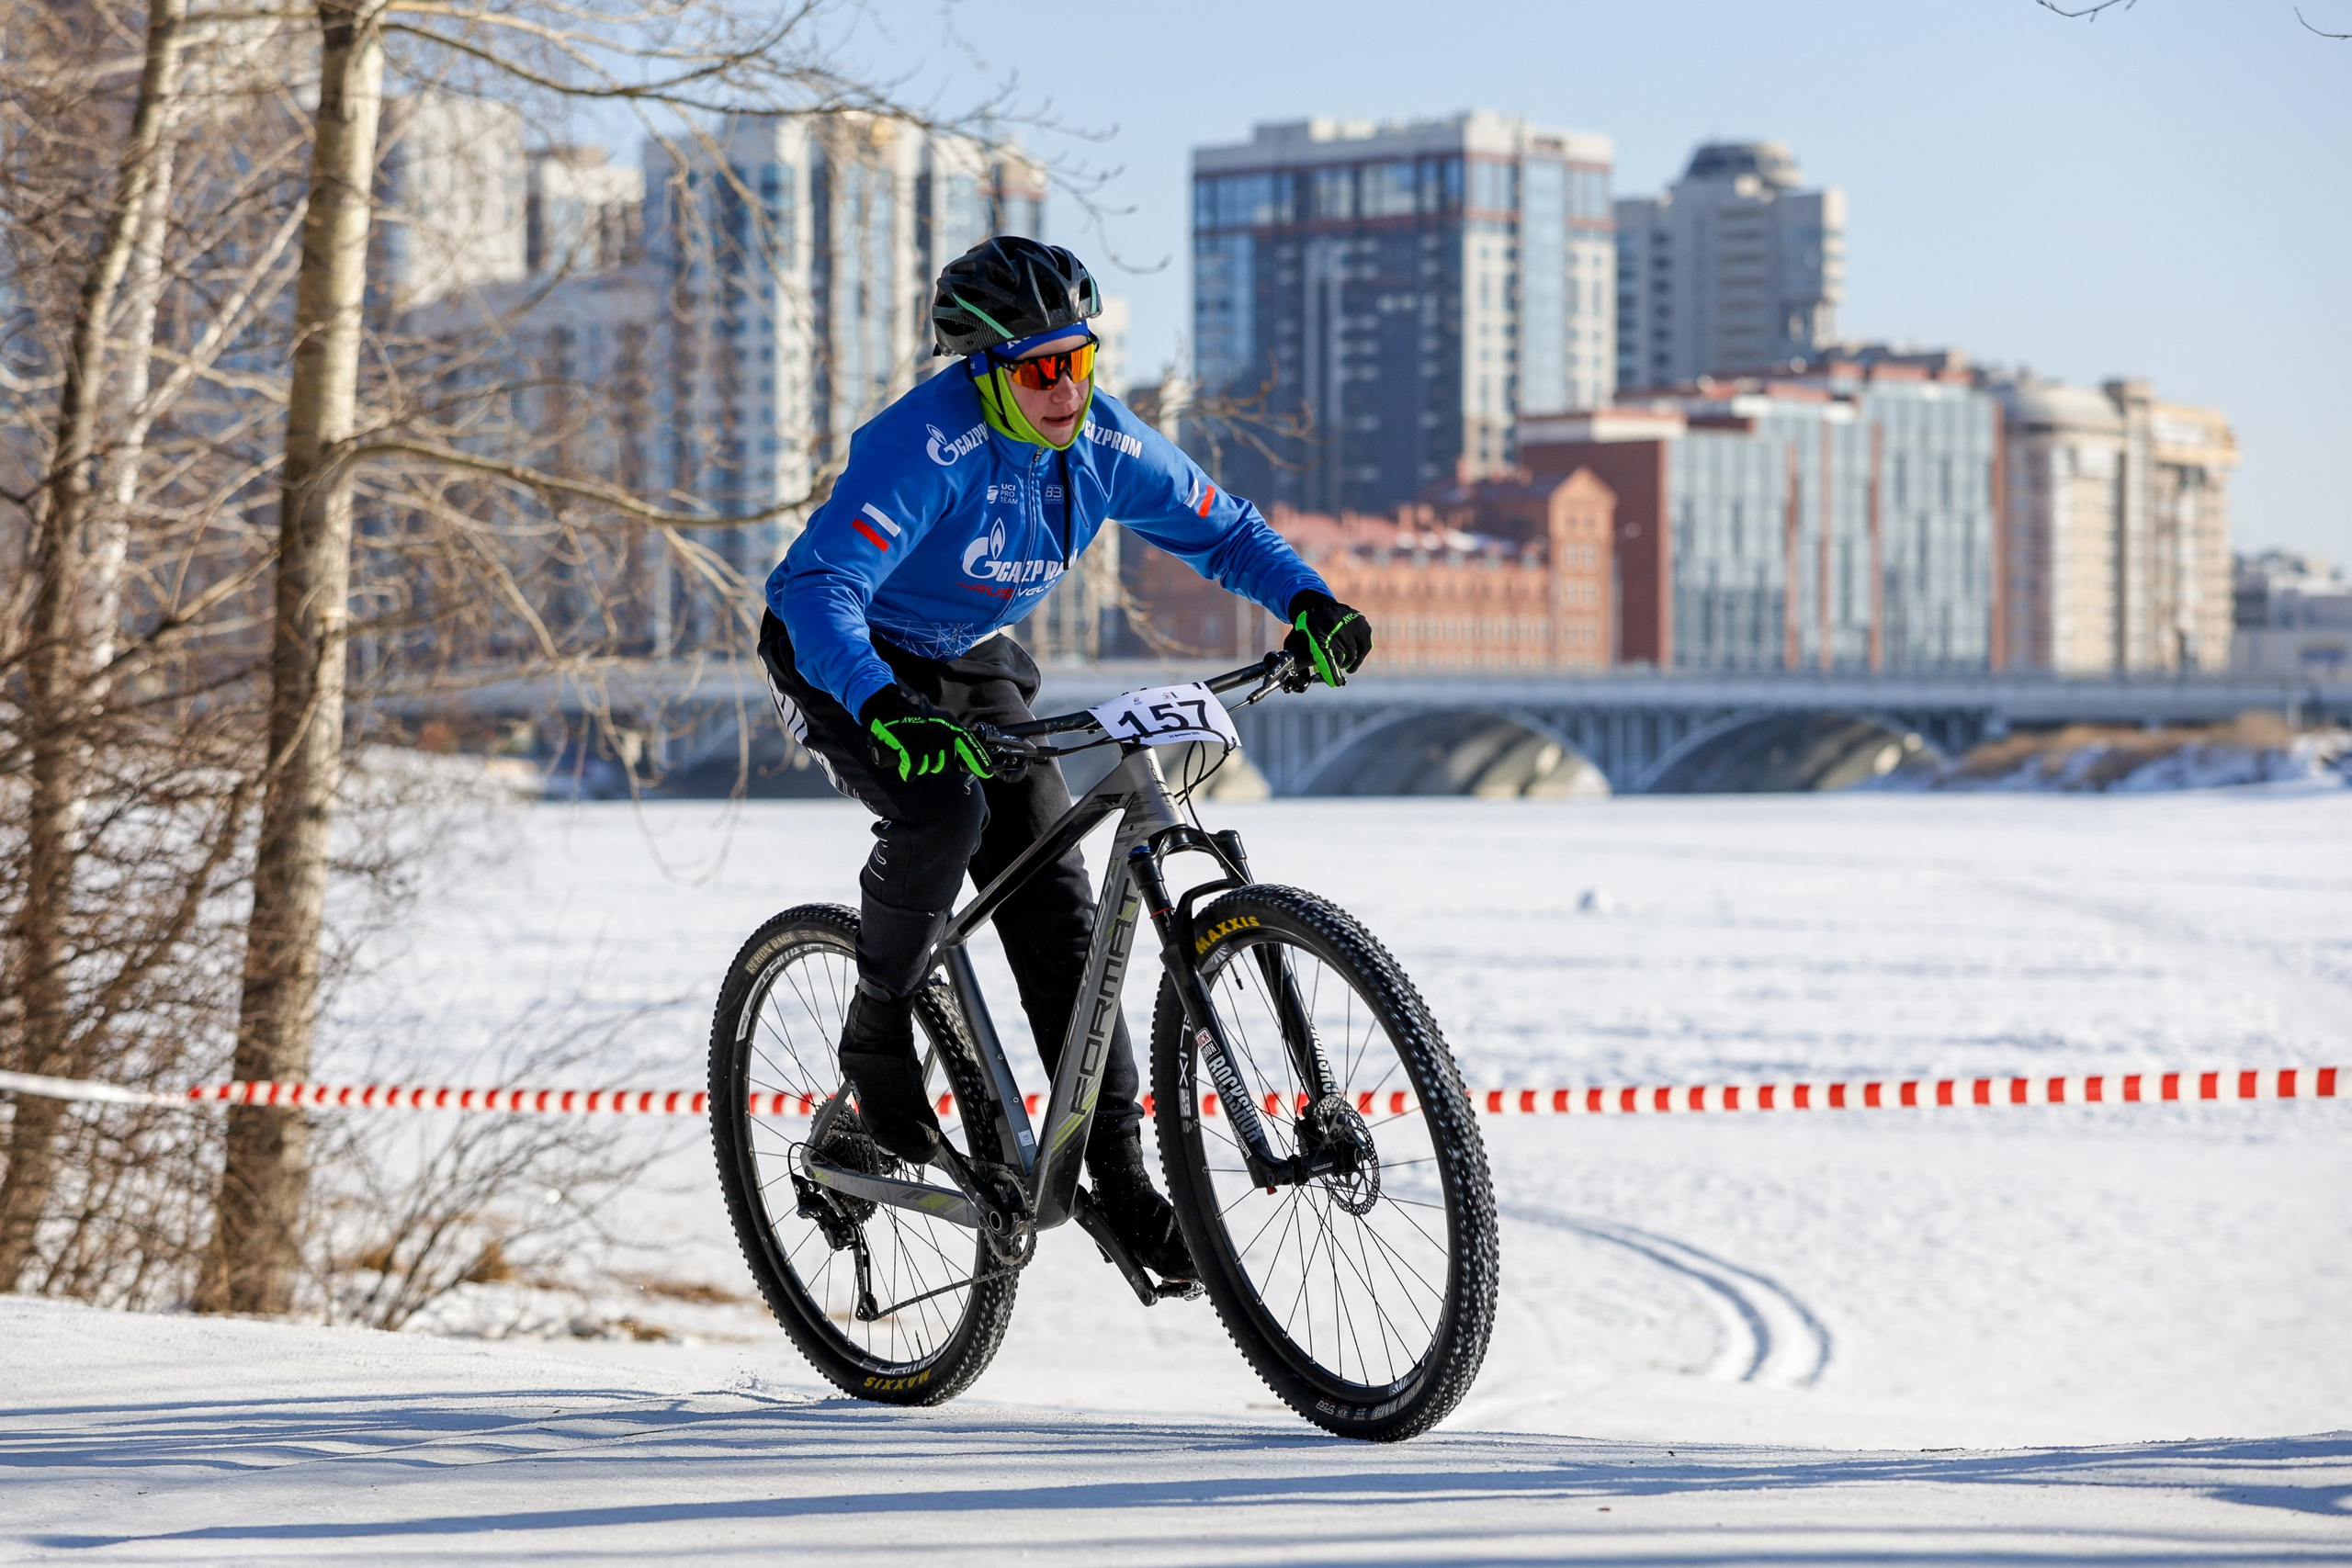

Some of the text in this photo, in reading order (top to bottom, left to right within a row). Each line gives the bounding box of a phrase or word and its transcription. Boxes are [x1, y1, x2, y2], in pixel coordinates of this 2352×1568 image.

[956, 421, 989, 457] GAZPR
[1083, 420, 1143, 459] GAZPROM
[1000, 490, 1015, 498] PRO
[1000, 496, 1019, 505] TEAM
[1001, 483, 1016, 491] UCI
[1117, 699, 1212, 739] 157
[744, 942, 774, 976] REKON
[770, 930, 798, 951] RACE
[1195, 916, 1261, 954] MAXXIS
[1069, 877, 1138, 1116] FORMAT
[1179, 1014, 1192, 1088] LIX
[1208, 1055, 1262, 1144] ROCKSHOX
[864, 1367, 933, 1391] MAXXIS
